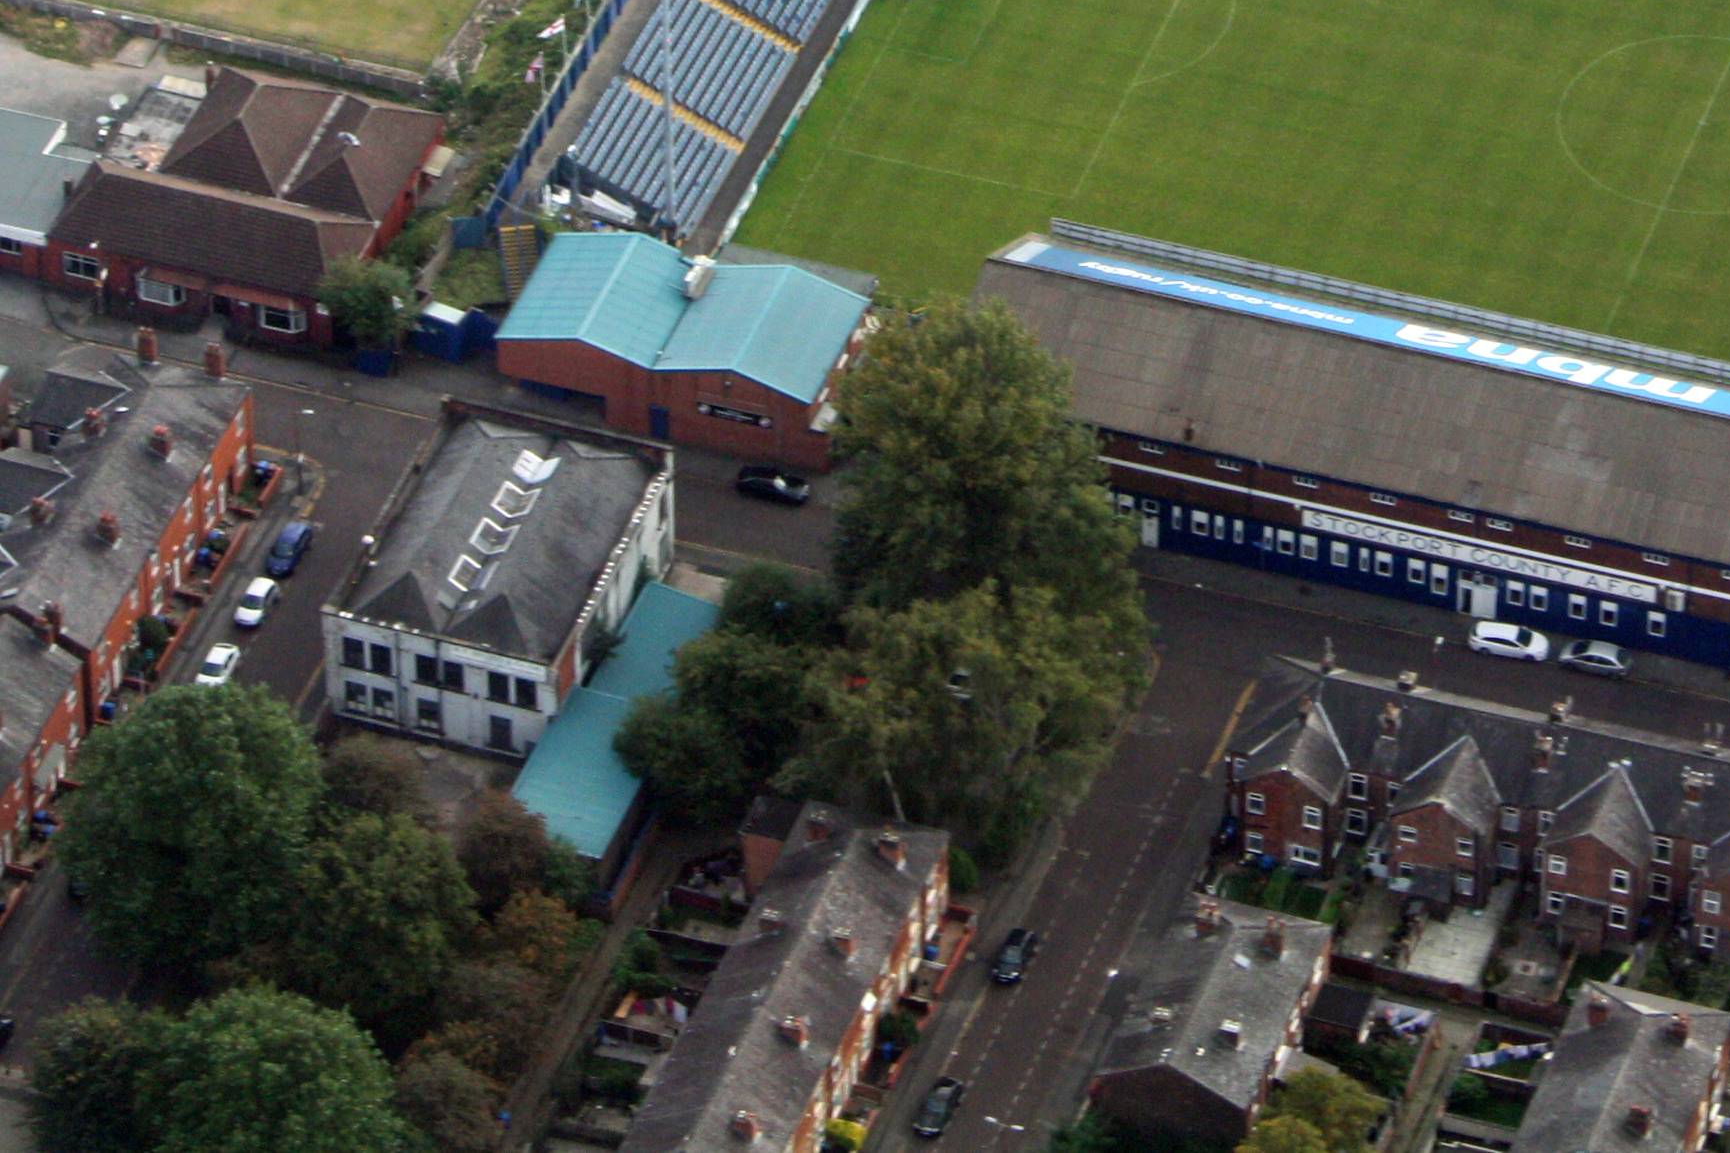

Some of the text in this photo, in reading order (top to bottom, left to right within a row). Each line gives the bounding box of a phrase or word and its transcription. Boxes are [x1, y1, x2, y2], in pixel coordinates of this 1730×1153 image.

[1078, 260, 1354, 325] mbna.co.uk/rugby
[1395, 323, 1717, 405] mbna
[1310, 512, 1464, 561] STOCKPORT
[1470, 547, 1571, 585] COUNTY
